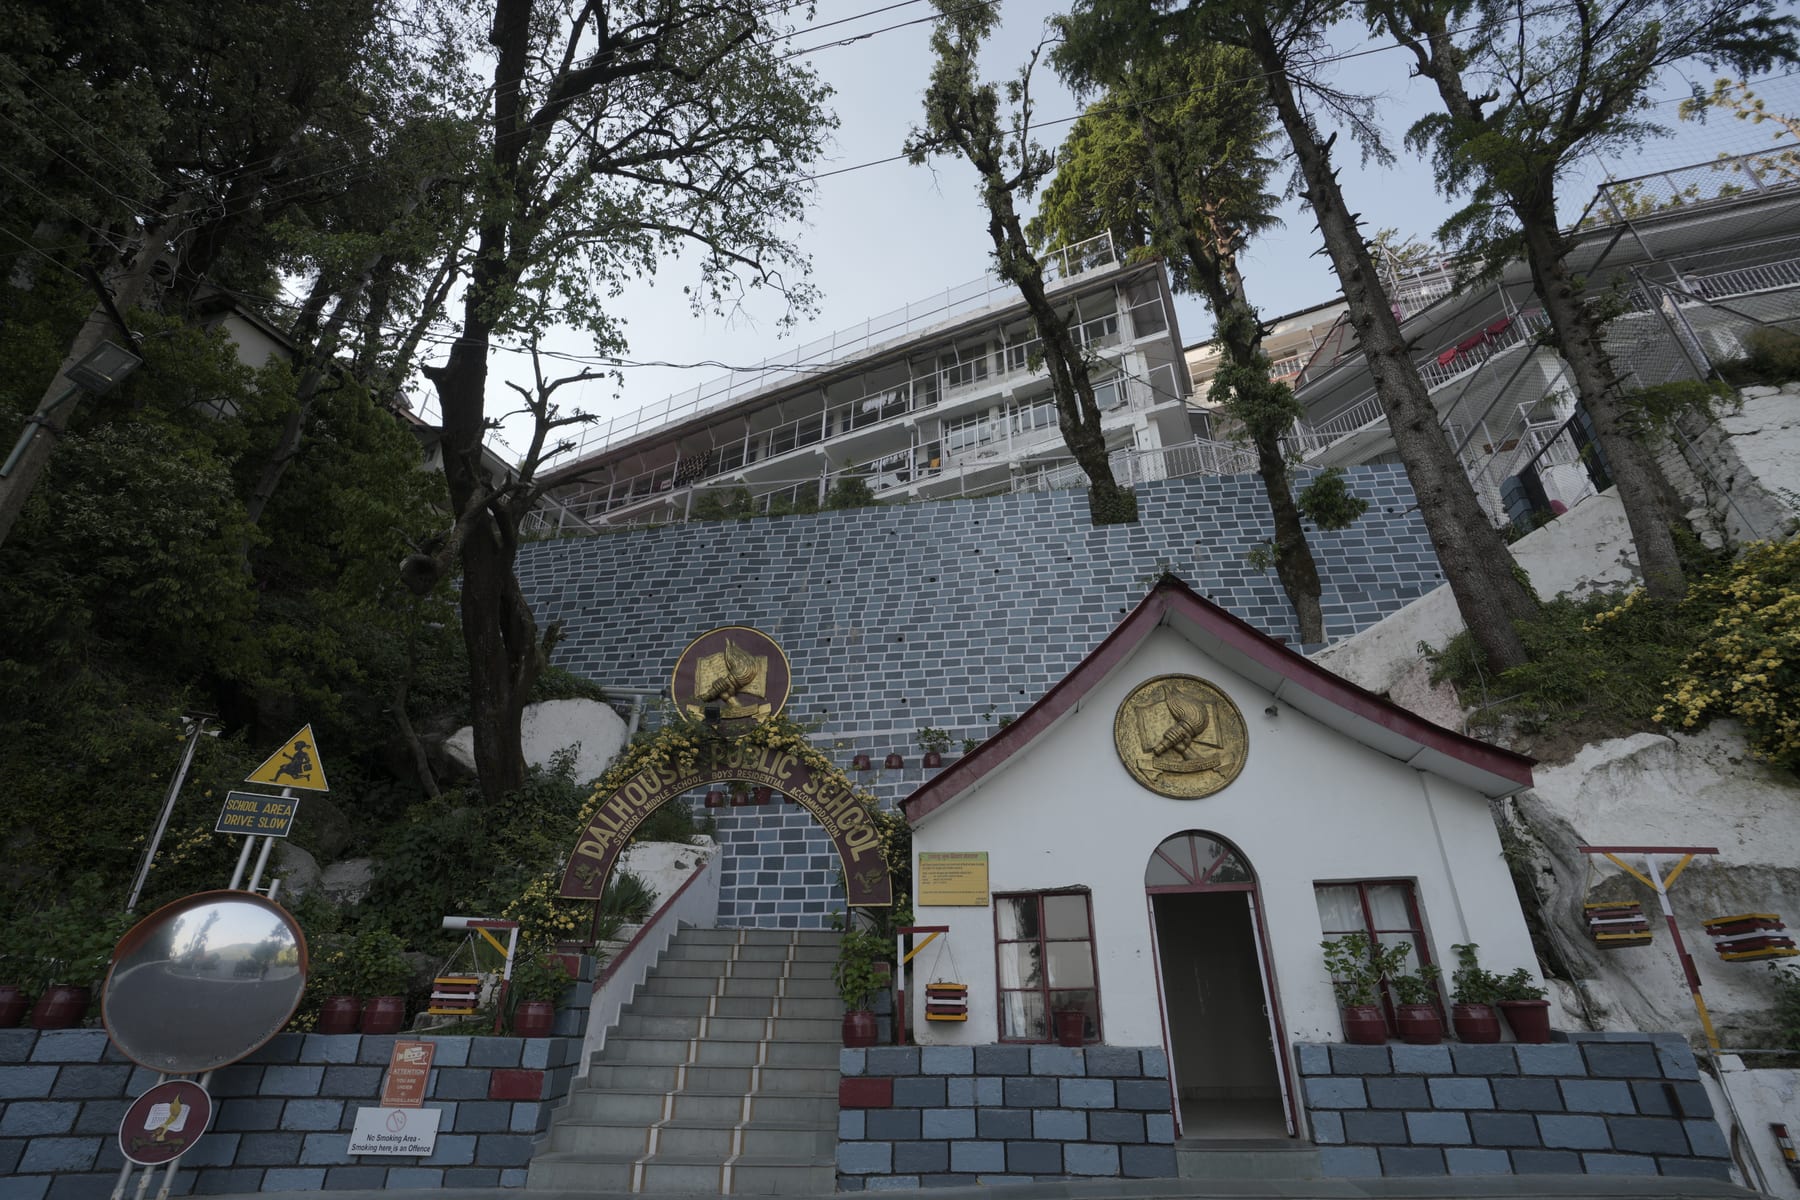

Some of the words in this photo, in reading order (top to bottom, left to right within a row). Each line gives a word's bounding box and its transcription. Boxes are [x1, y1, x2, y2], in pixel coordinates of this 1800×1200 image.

[226, 799, 259, 812] SCHOOL
[262, 803, 292, 817] AREA
[613, 814, 640, 846] SENIOR
[644, 788, 671, 812] MIDDLE
[672, 776, 703, 792] SCHOOL
[711, 769, 733, 780] BOYS
[737, 769, 785, 790] RESIDENTIAL
[790, 787, 841, 839] ACCOMMODATION
[710, 742, 798, 780] PUBLIC
[802, 772, 879, 862] SCHOOL
[224, 814, 255, 827] DRIVE
[258, 817, 288, 829] SLOW
[376, 1134, 402, 1143] Smoking
[351, 1144, 377, 1152] Smoking
[408, 1144, 431, 1152] Offence
